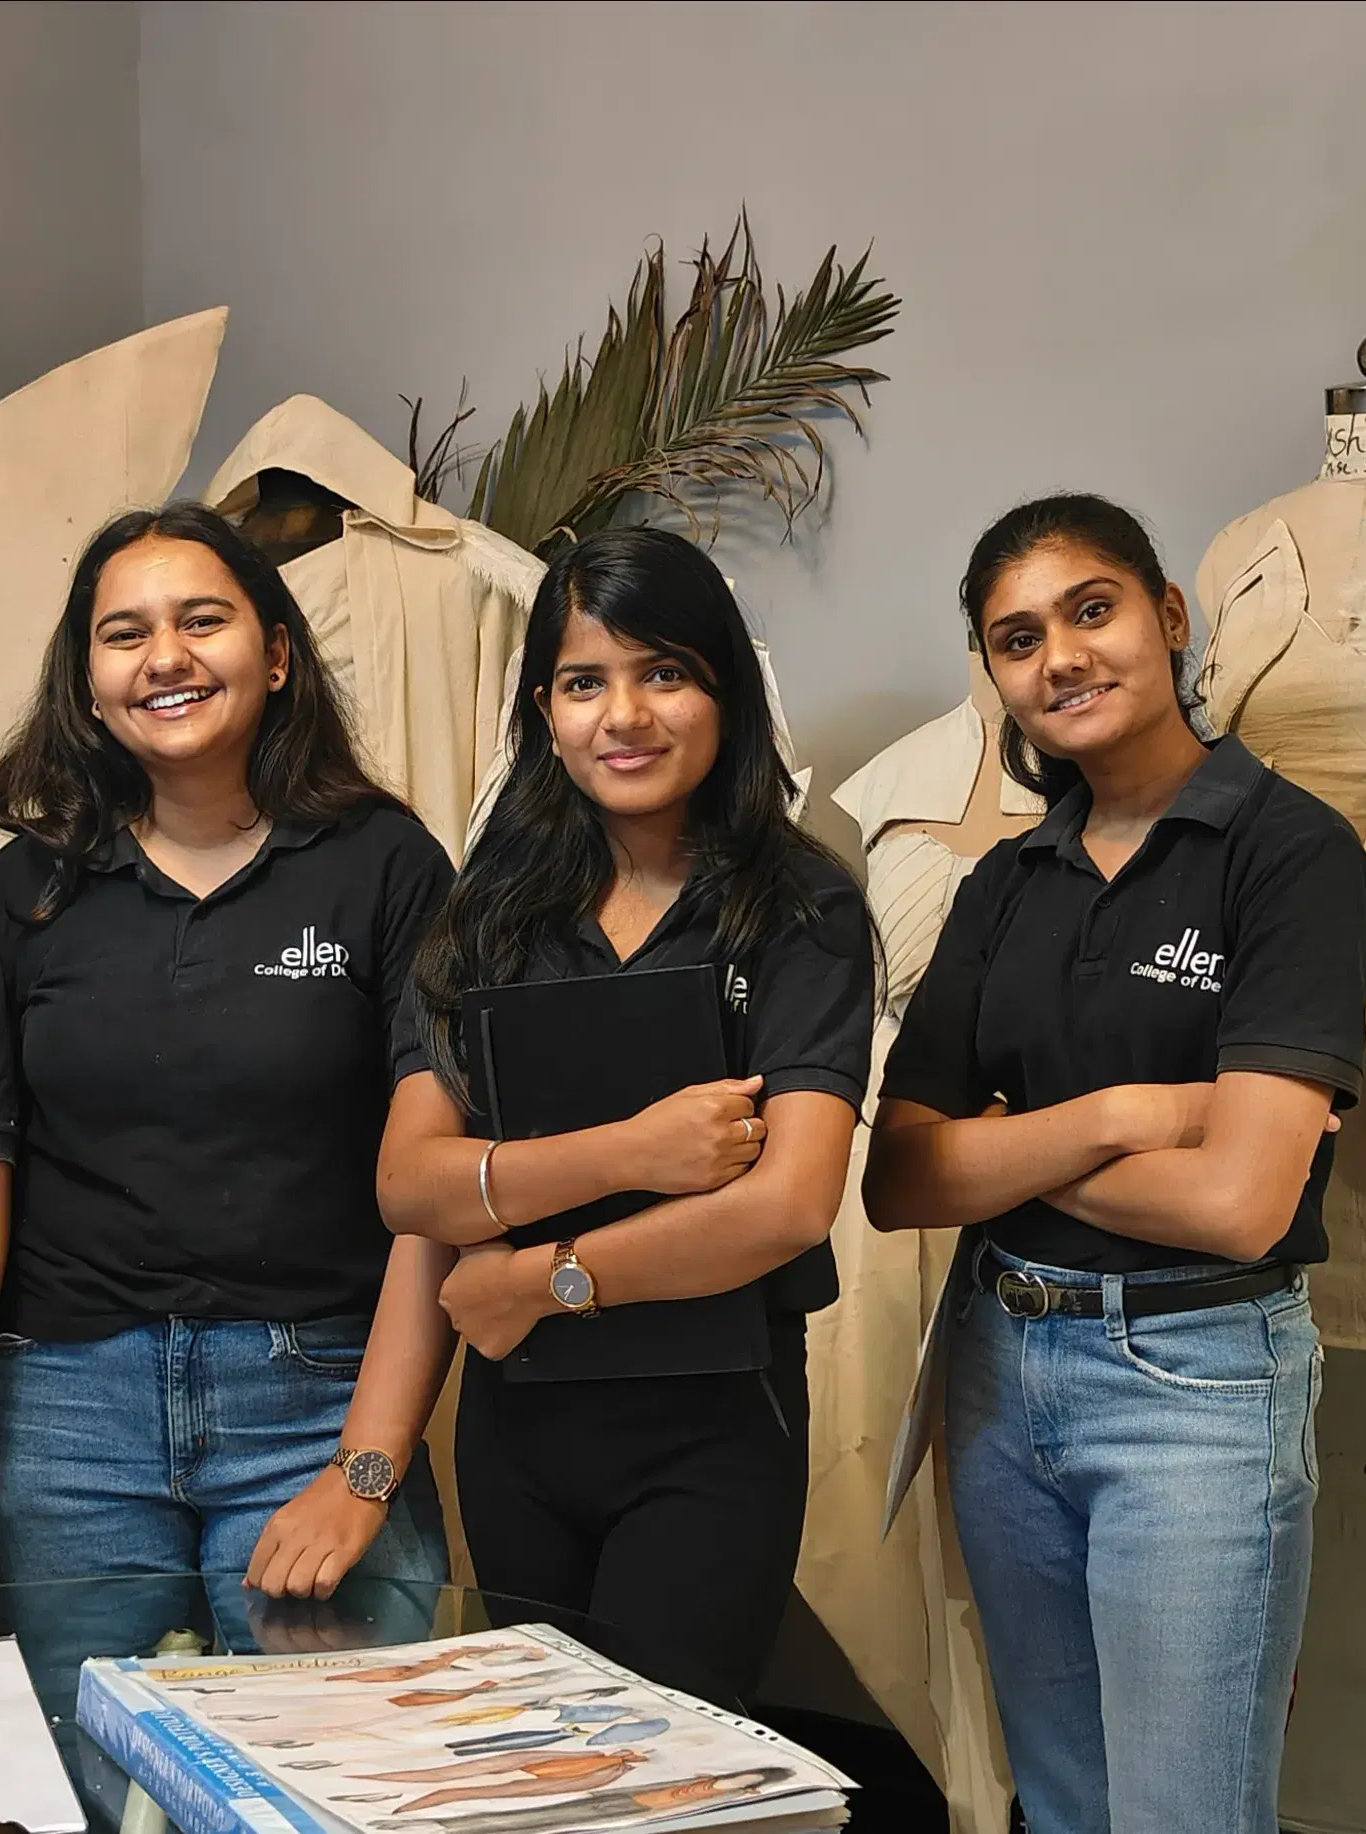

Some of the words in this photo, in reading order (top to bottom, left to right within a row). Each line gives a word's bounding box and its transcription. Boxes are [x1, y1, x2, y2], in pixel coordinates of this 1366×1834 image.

[254, 963, 309, 980] College
[312, 964, 327, 977] of
[1130, 961, 1177, 984] College
[1180, 975, 1200, 989] of
